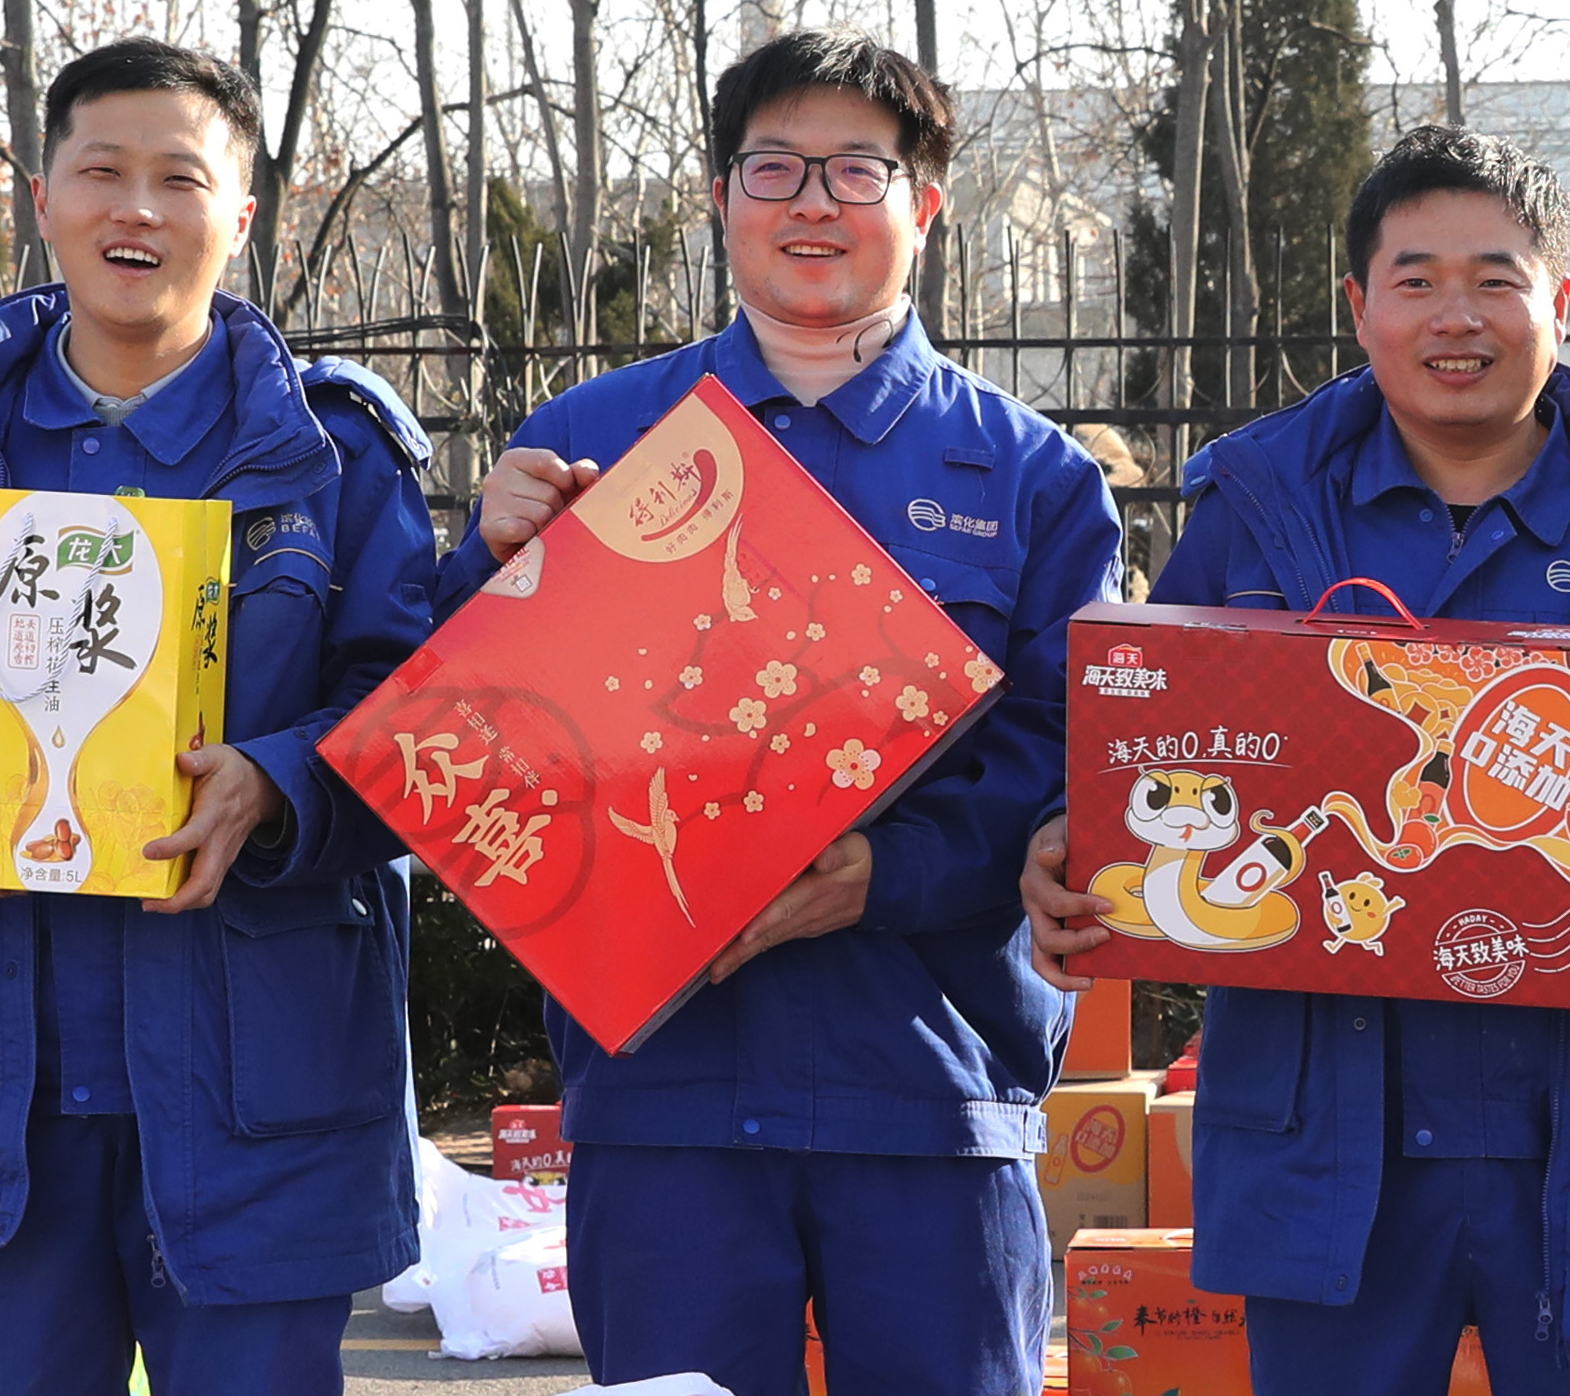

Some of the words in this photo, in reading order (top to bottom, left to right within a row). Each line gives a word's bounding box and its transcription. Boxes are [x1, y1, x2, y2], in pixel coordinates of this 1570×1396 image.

[69, 536, 123, 565] 龙大
[1082, 665, 1168, 690] 海天致美味
[20, 865, 83, 884] 净含量:5L
[1458, 915, 1488, 926] HADAY
[1433, 934, 1529, 971] 海天致美味
